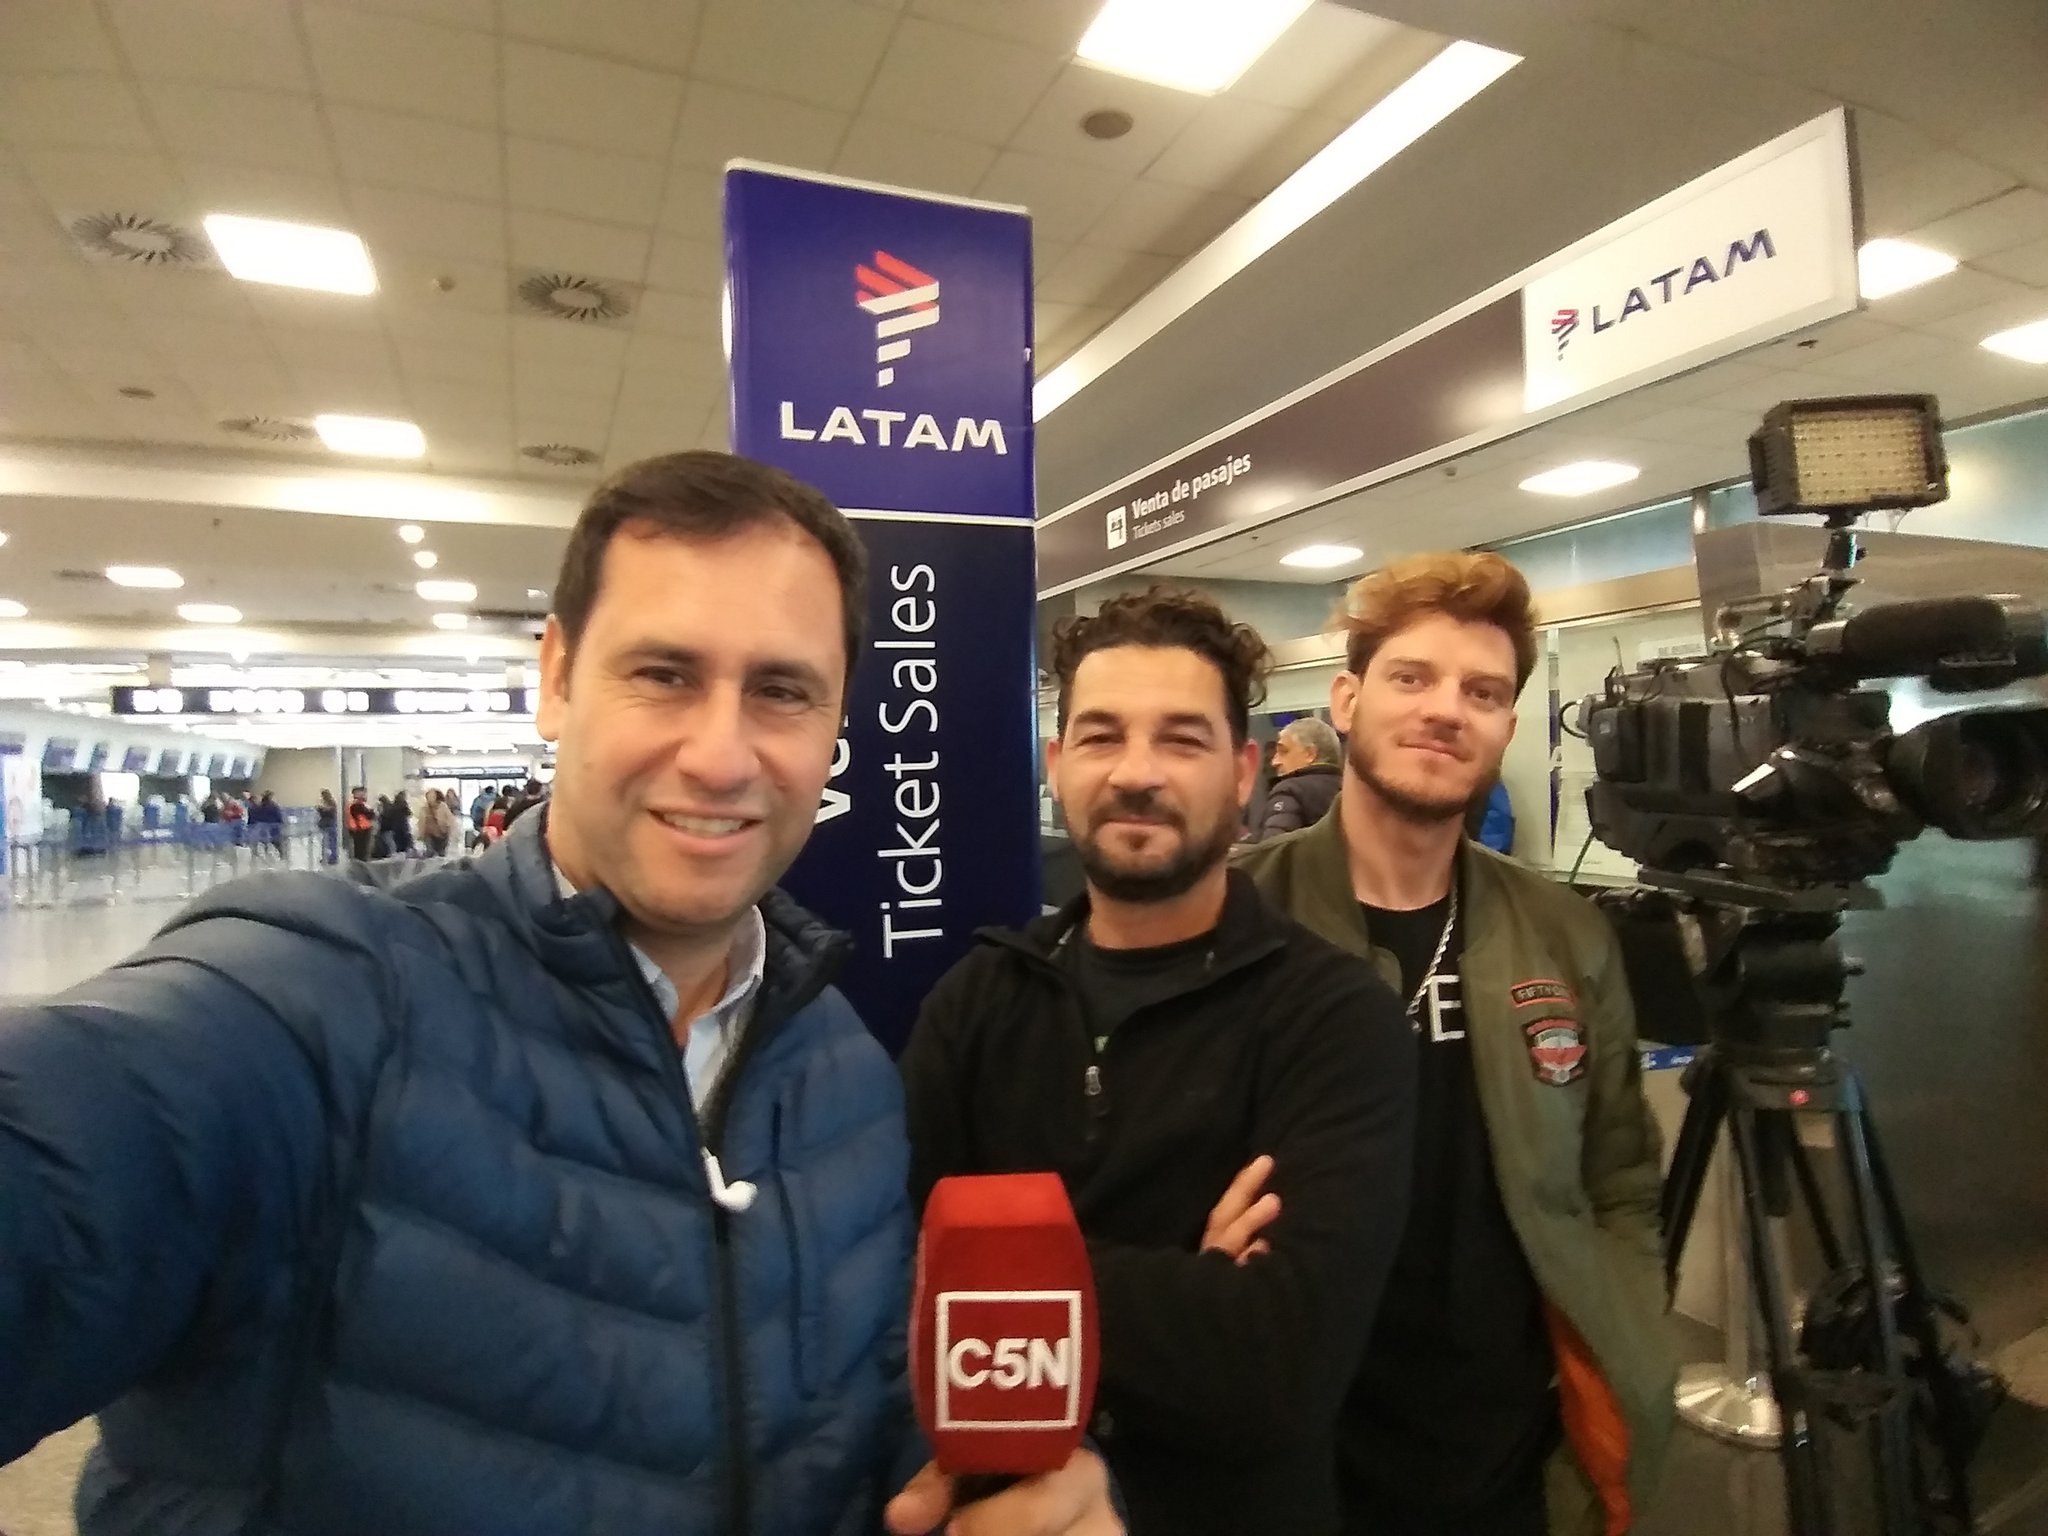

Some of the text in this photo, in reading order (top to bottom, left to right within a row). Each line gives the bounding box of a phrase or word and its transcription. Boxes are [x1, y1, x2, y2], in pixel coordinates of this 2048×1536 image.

[1592, 227, 1778, 334] LATAM
[779, 400, 1008, 456] LATAM
[1131, 453, 1251, 520] Venta de pasajes
[1132, 509, 1186, 539] Tickets sales
[873, 563, 944, 959] Ticket Sales
[947, 1337, 1070, 1391] C5N
